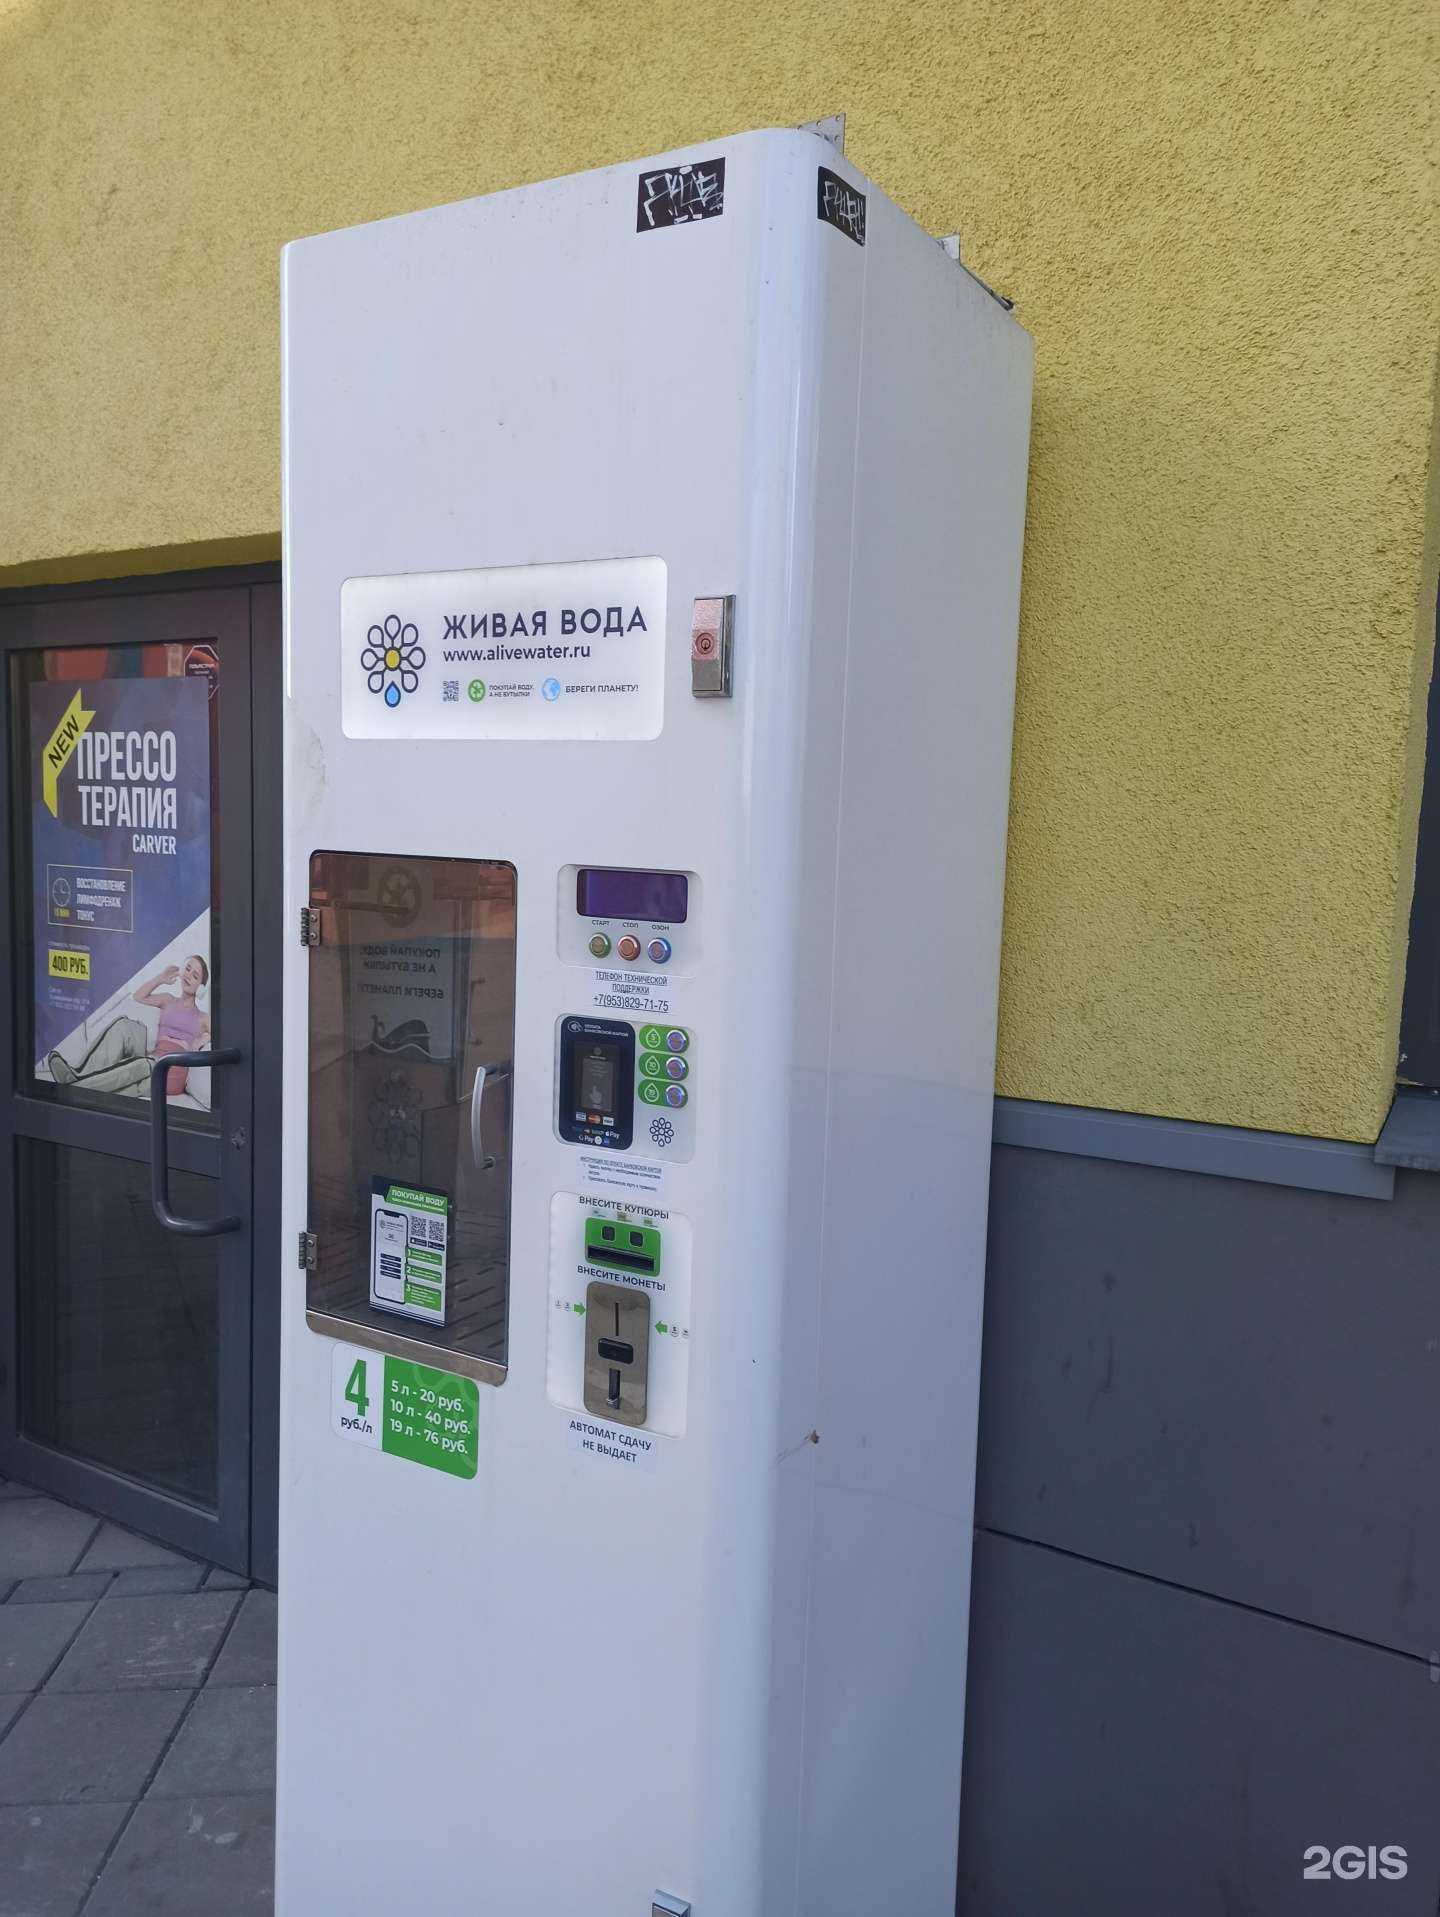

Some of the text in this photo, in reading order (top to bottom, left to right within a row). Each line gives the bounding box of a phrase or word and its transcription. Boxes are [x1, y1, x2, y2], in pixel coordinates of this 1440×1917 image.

[442, 605, 648, 640] ЖИВАЯ ВОДА
[442, 644, 591, 662] www.alivewater.ru
[488, 684, 517, 692] ПОКУПАЙ
[565, 683, 640, 694] БЕРЕГИ ПЛАНЕТУ!
[48, 713, 80, 769] NEW
[76, 730, 177, 782] ПРЕССО
[77, 785, 177, 830] ТЕРАПИЯ
[132, 834, 177, 855] CARVER
[591, 919, 610, 927] СТАРТ
[622, 921, 639, 929] СТОП
[651, 924, 670, 932] ОЗОН
[52, 955, 89, 975] 400 РУБ.
[595, 971, 668, 986] ТЕЛЕФОН ТЕХНИЧЕСКОЙ
[612, 983, 650, 995] ПОДДЕРЖКИ
[593, 993, 670, 1013] +7(953)829-71-75
[391, 1189, 425, 1202] ПОКУПАЙ
[579, 1195, 669, 1220] ВНЕСИТЕ КУПЮРЫ
[577, 1265, 666, 1292] ВНЕСИТЕ МОНЕТЫ
[344, 1359, 370, 1417] 4
[391, 1380, 399, 1393] 5
[401, 1385, 410, 1396] л
[420, 1388, 436, 1403] 20
[438, 1396, 465, 1413] руб.
[340, 1416, 373, 1434] руб./л
[390, 1398, 404, 1413] 10
[406, 1406, 415, 1417] л
[425, 1410, 442, 1425] 40
[444, 1418, 471, 1435] руб.
[390, 1418, 403, 1433] 19
[404, 1425, 413, 1437] л
[423, 1428, 439, 1445] 76
[441, 1437, 468, 1454] руб.
[569, 1420, 652, 1451] АВТОМАТ СДАЧУ
[582, 1439, 637, 1463] НЕ ВЫДАЕТ
